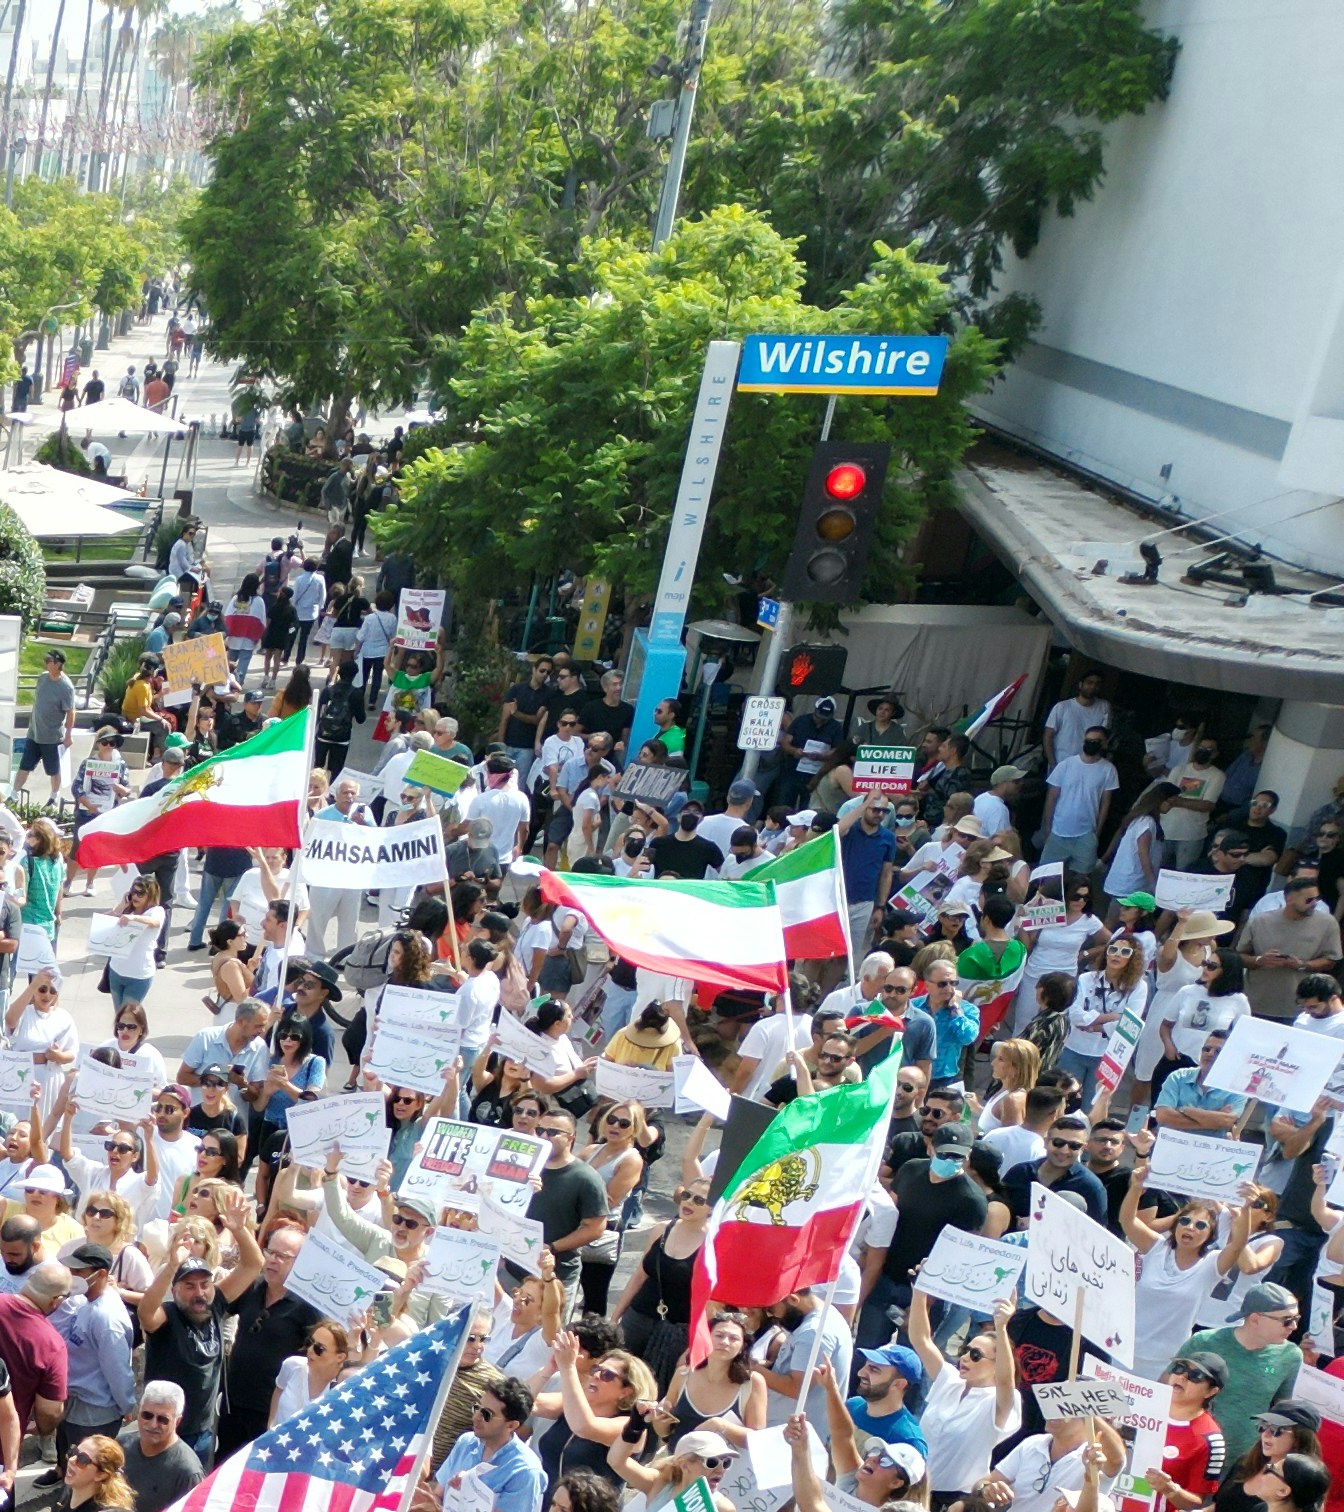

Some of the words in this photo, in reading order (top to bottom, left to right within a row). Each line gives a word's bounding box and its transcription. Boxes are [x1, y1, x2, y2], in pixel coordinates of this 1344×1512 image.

[757, 341, 931, 378] Wilshire
[683, 375, 726, 527] WILSHIRE
[750, 700, 780, 710] CROSS
[749, 718, 774, 727] WALK
[742, 728, 776, 738] SIGNAL
[745, 737, 770, 747] ONLY
[860, 750, 913, 761] WOMEN
[870, 764, 898, 775] LIFE
[854, 779, 907, 791] FREEDOM
[432, 1132, 471, 1162] LIFE
[501, 1138, 537, 1154] FREE
[1038, 1386, 1072, 1401] SAY
[1081, 1388, 1122, 1403] HER
[1057, 1401, 1114, 1417] NAME
